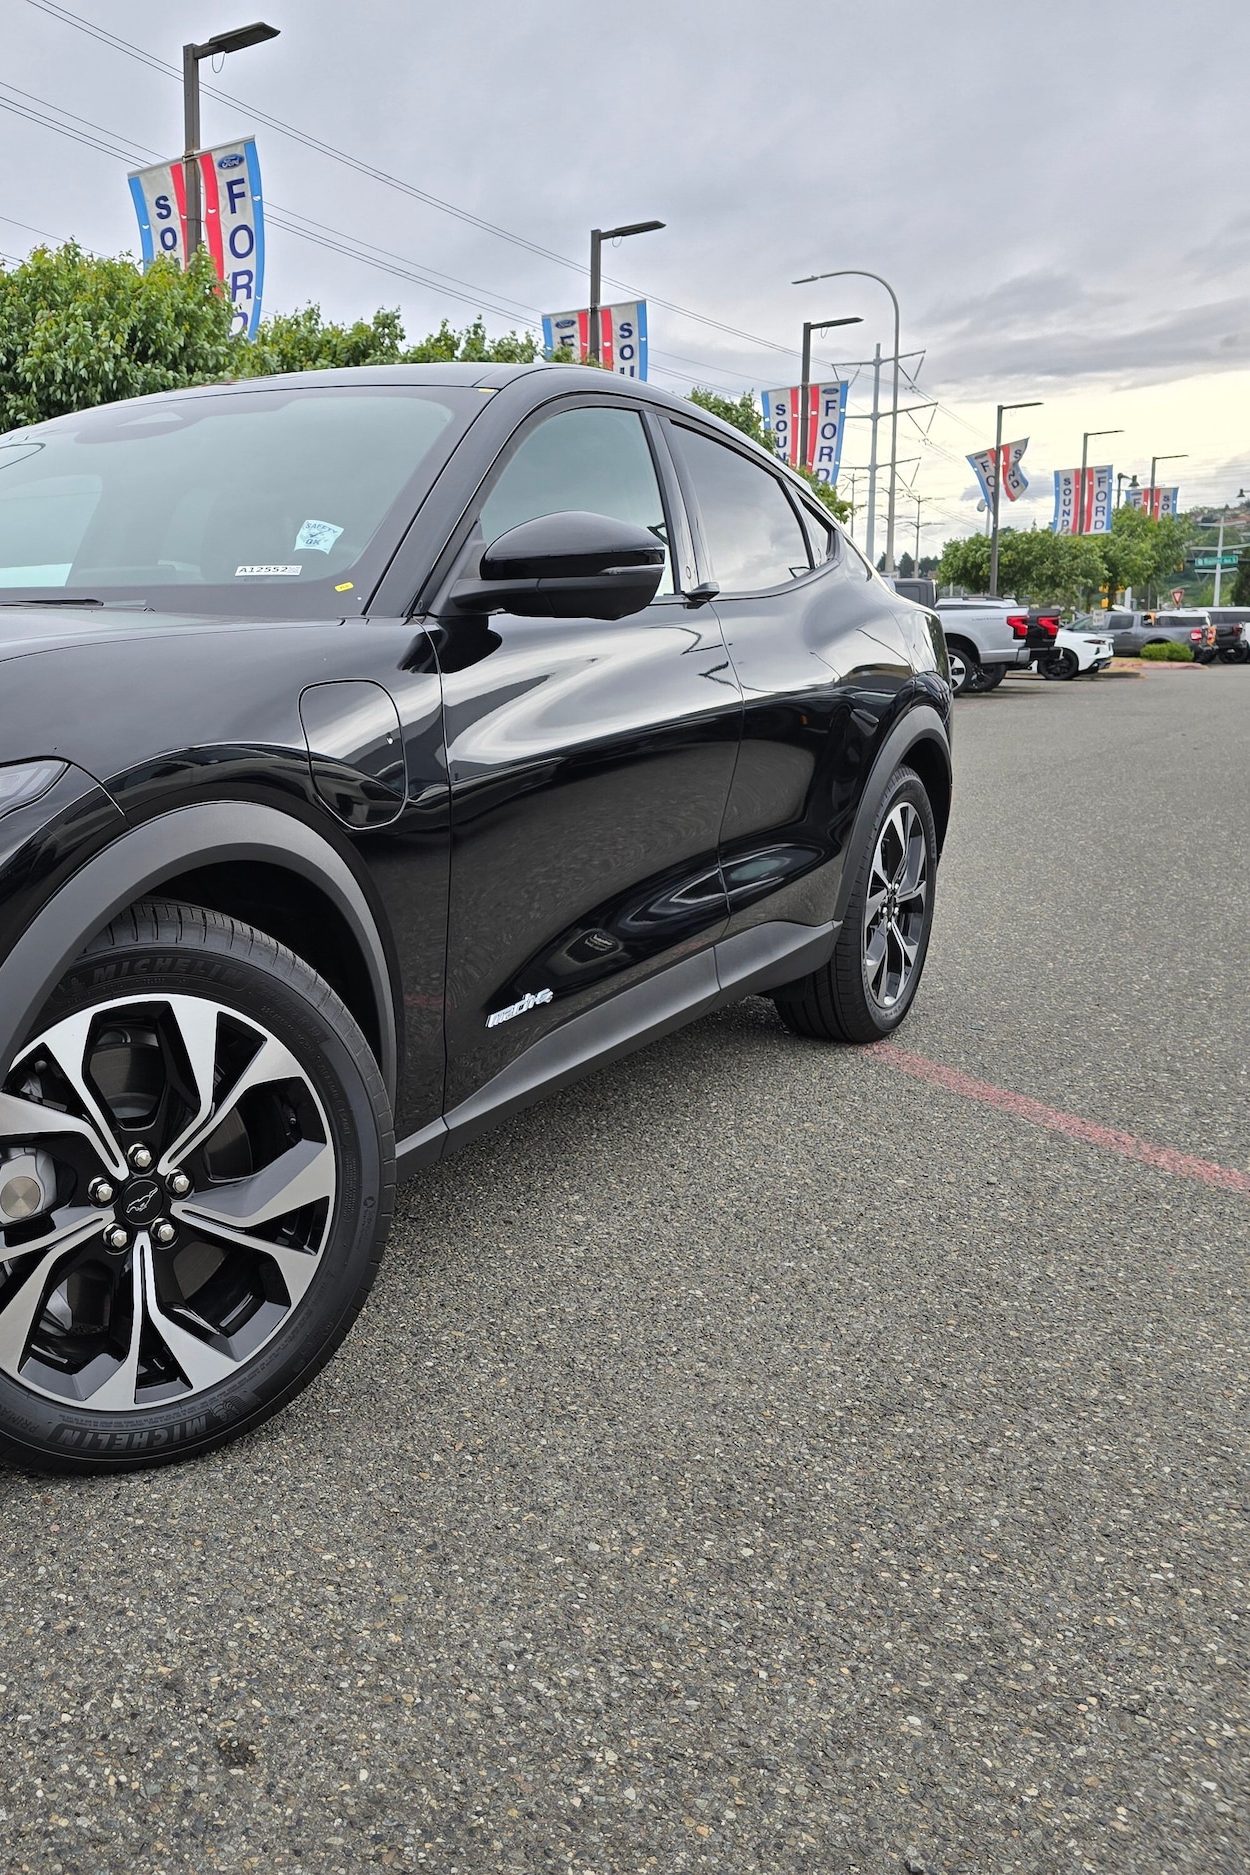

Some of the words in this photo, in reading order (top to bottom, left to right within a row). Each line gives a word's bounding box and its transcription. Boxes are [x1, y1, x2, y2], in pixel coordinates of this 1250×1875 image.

[1094, 477, 1107, 530] FORD
[305, 522, 339, 534] SAFETY
[238, 566, 289, 574] A12552
[92, 956, 245, 986] MICHELIN
[57, 1415, 207, 1450] MICHELIN
